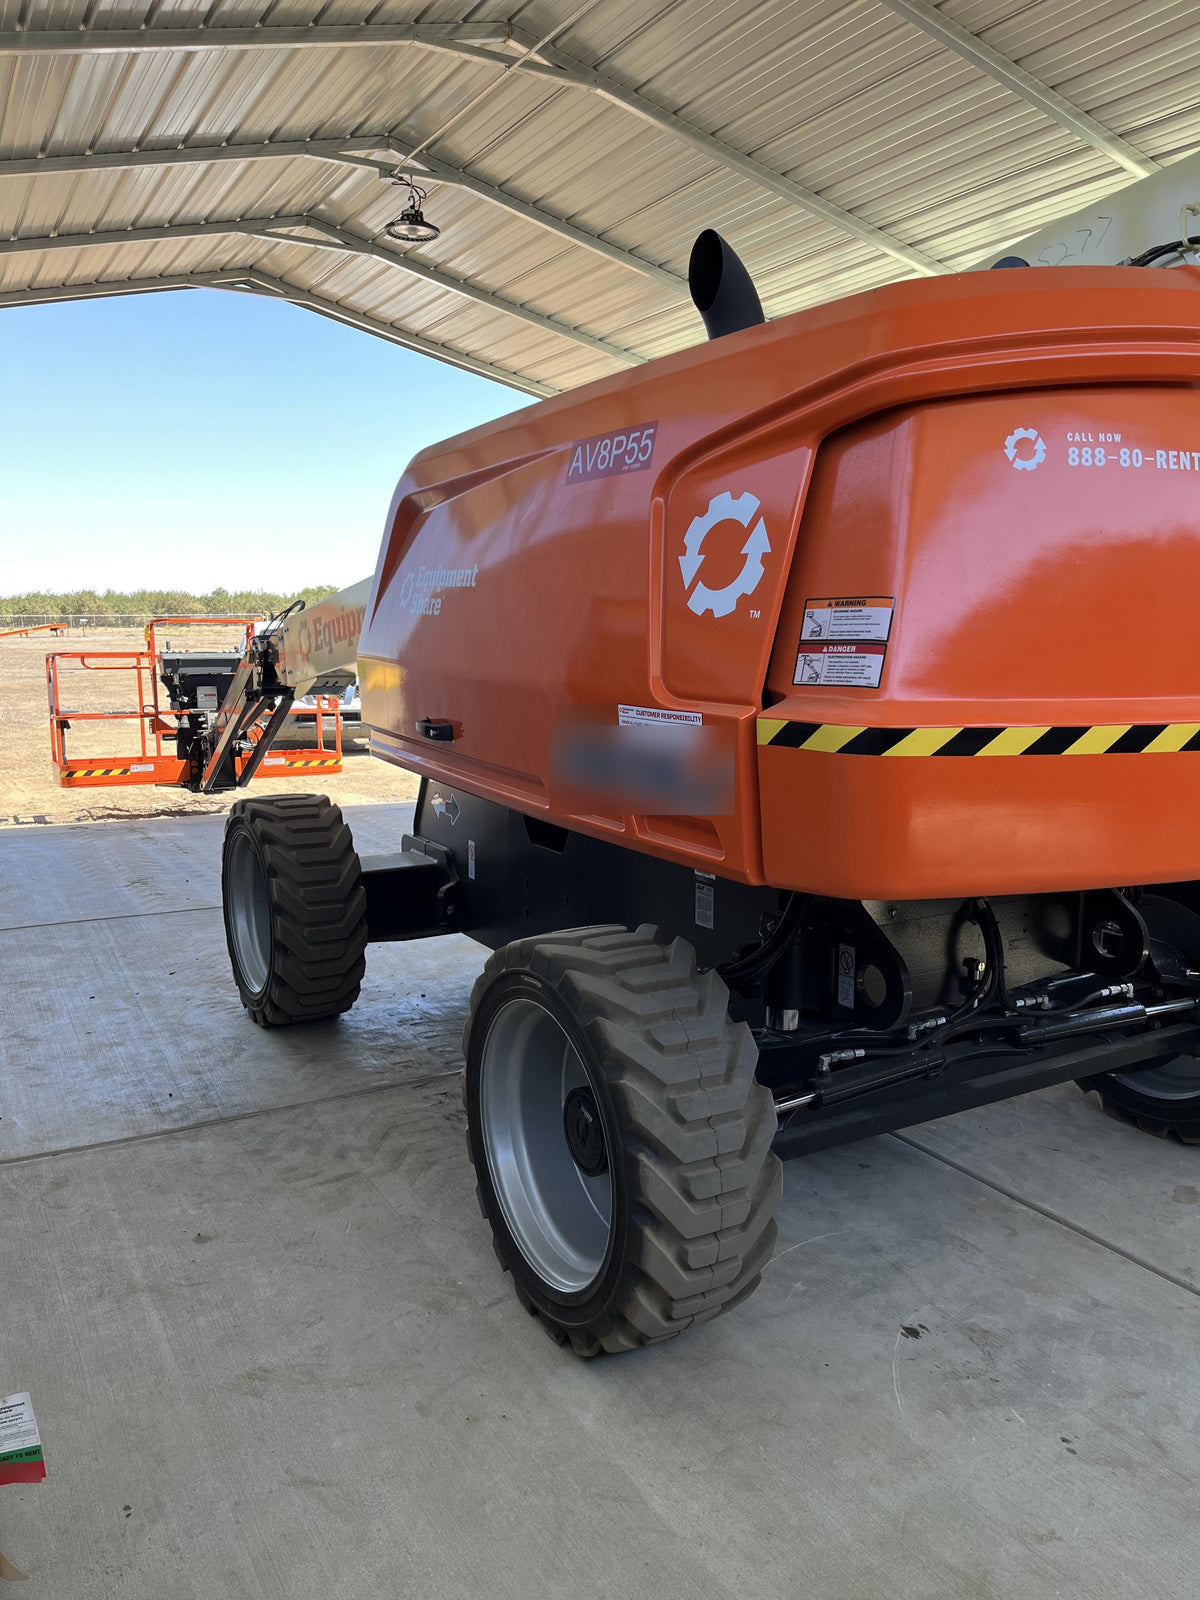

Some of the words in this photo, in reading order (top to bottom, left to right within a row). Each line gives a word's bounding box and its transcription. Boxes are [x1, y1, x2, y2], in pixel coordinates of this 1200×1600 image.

[1067, 432, 1094, 442] CALL
[1099, 433, 1121, 442] NOW
[568, 428, 655, 477] AV8P55
[415, 564, 479, 593] Equipment
[834, 599, 867, 607] WARNING
[749, 610, 761, 619] TM
[828, 645, 856, 653] DANGER
[635, 709, 661, 718] CUSTOMER
[661, 712, 702, 723] RESPONSIBILITY
